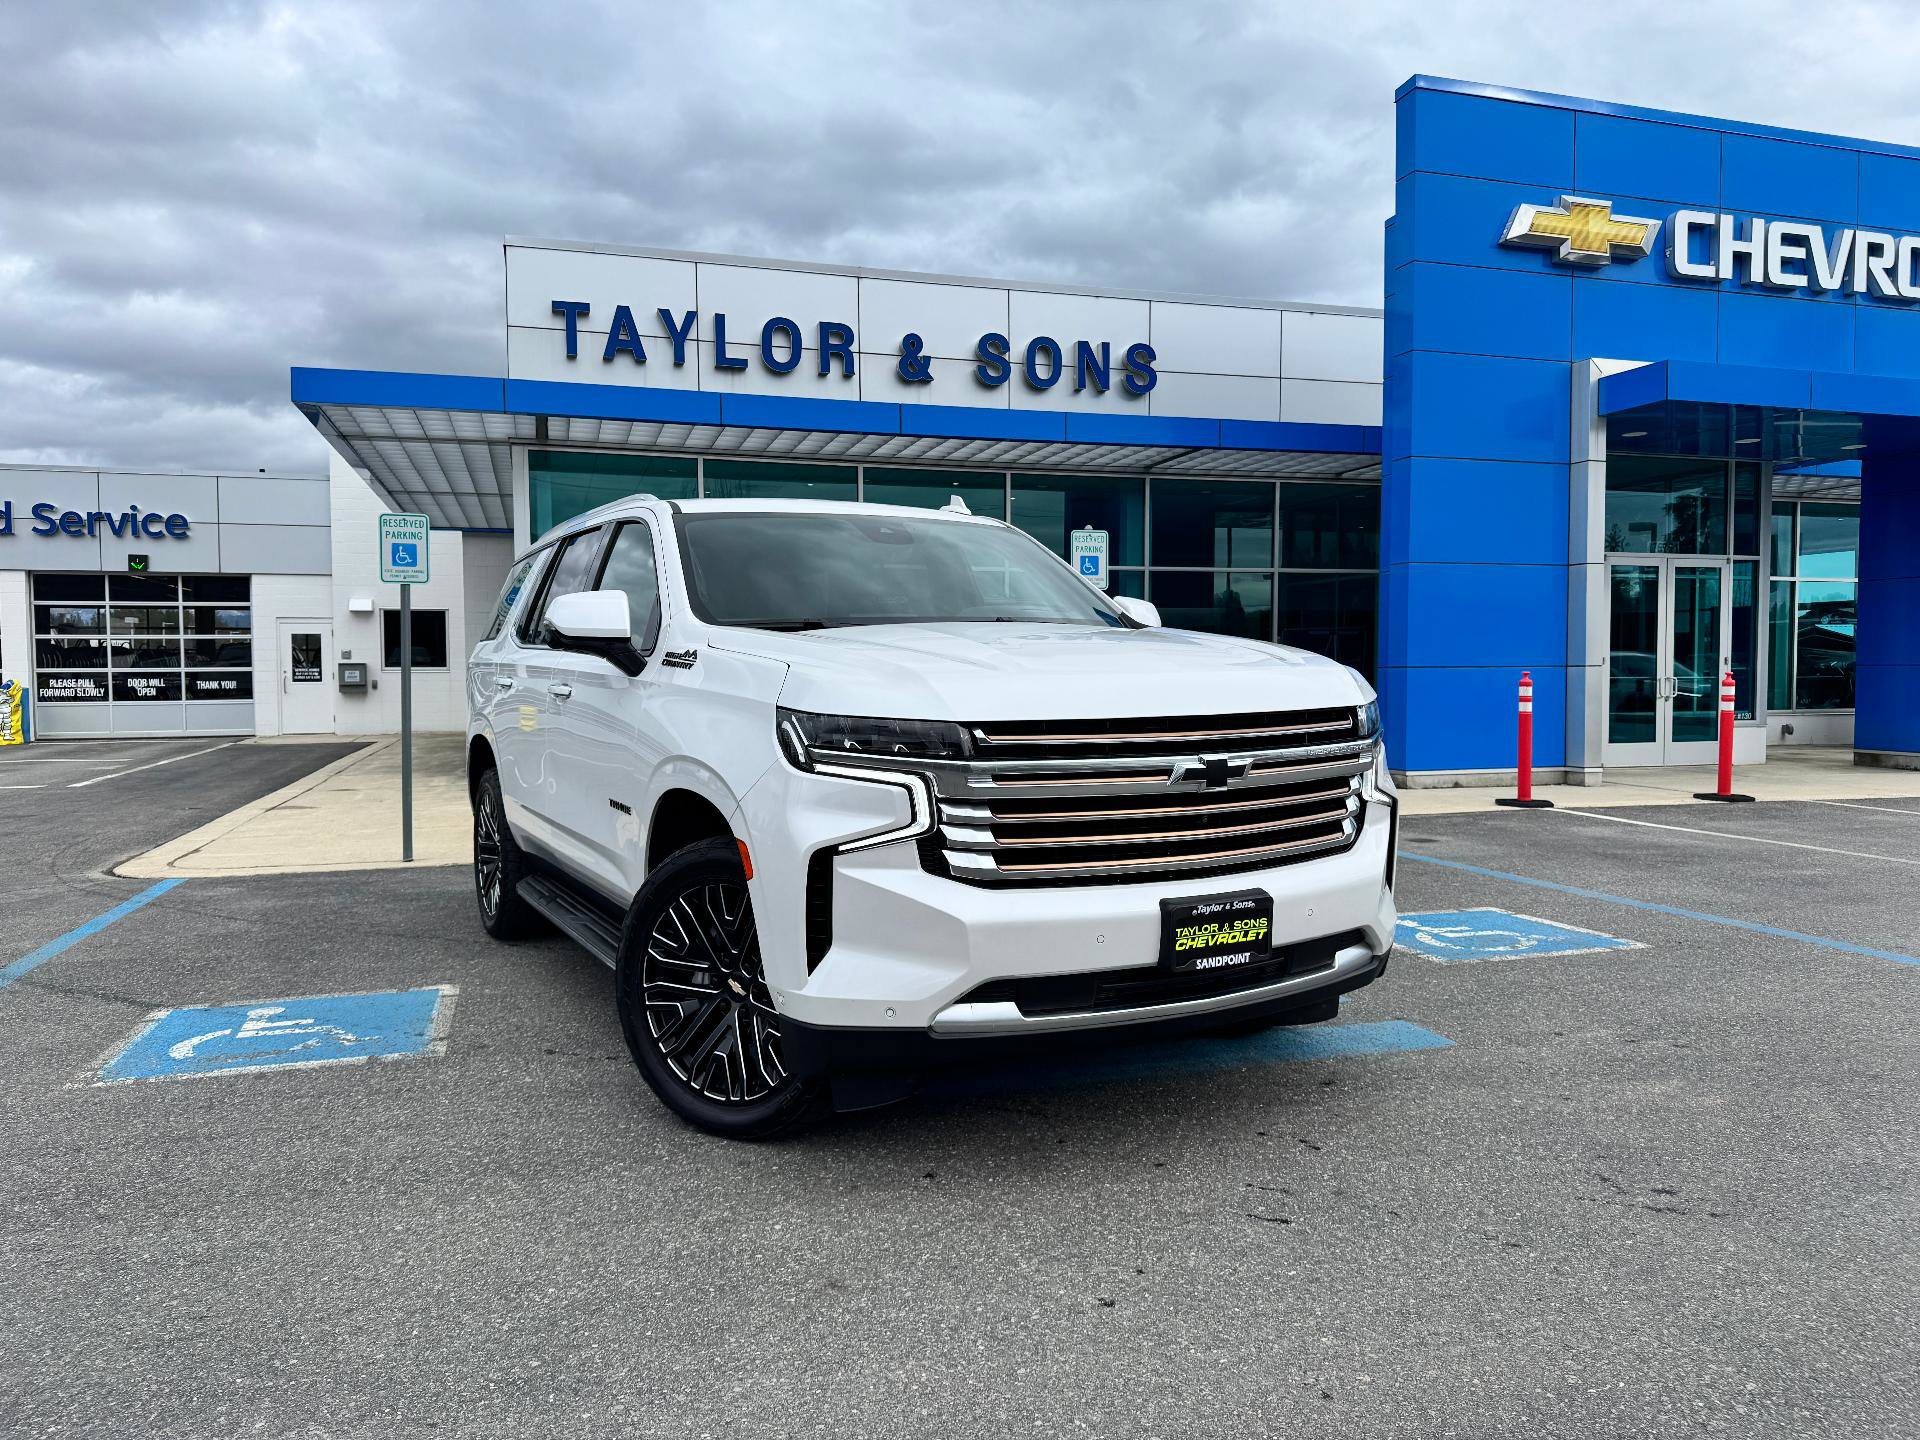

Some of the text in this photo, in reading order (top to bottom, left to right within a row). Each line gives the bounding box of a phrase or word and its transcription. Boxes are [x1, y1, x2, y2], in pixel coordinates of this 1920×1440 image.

[551, 300, 1158, 395] TAYLOR & SONS
[31, 502, 191, 539] Service
[383, 518, 424, 529] RESERVED
[385, 530, 423, 540] PARKING
[1074, 535, 1105, 543] RESERVED
[1075, 545, 1104, 553] PARKING
[49, 678, 96, 688] PLEASE PULL
[127, 678, 166, 688] DOOR WILL
[196, 680, 237, 690] THANK YOU!
[39, 687, 105, 698] FORWARD SLOWLY
[137, 687, 157, 697] OPEN
[1197, 903, 1224, 915] Taylor
[1232, 900, 1252, 909] Sons
[1175, 917, 1268, 938] TAYLOR & SONS
[1175, 928, 1268, 951] CHEVROLET
[1195, 952, 1251, 970] SANDPOINT
